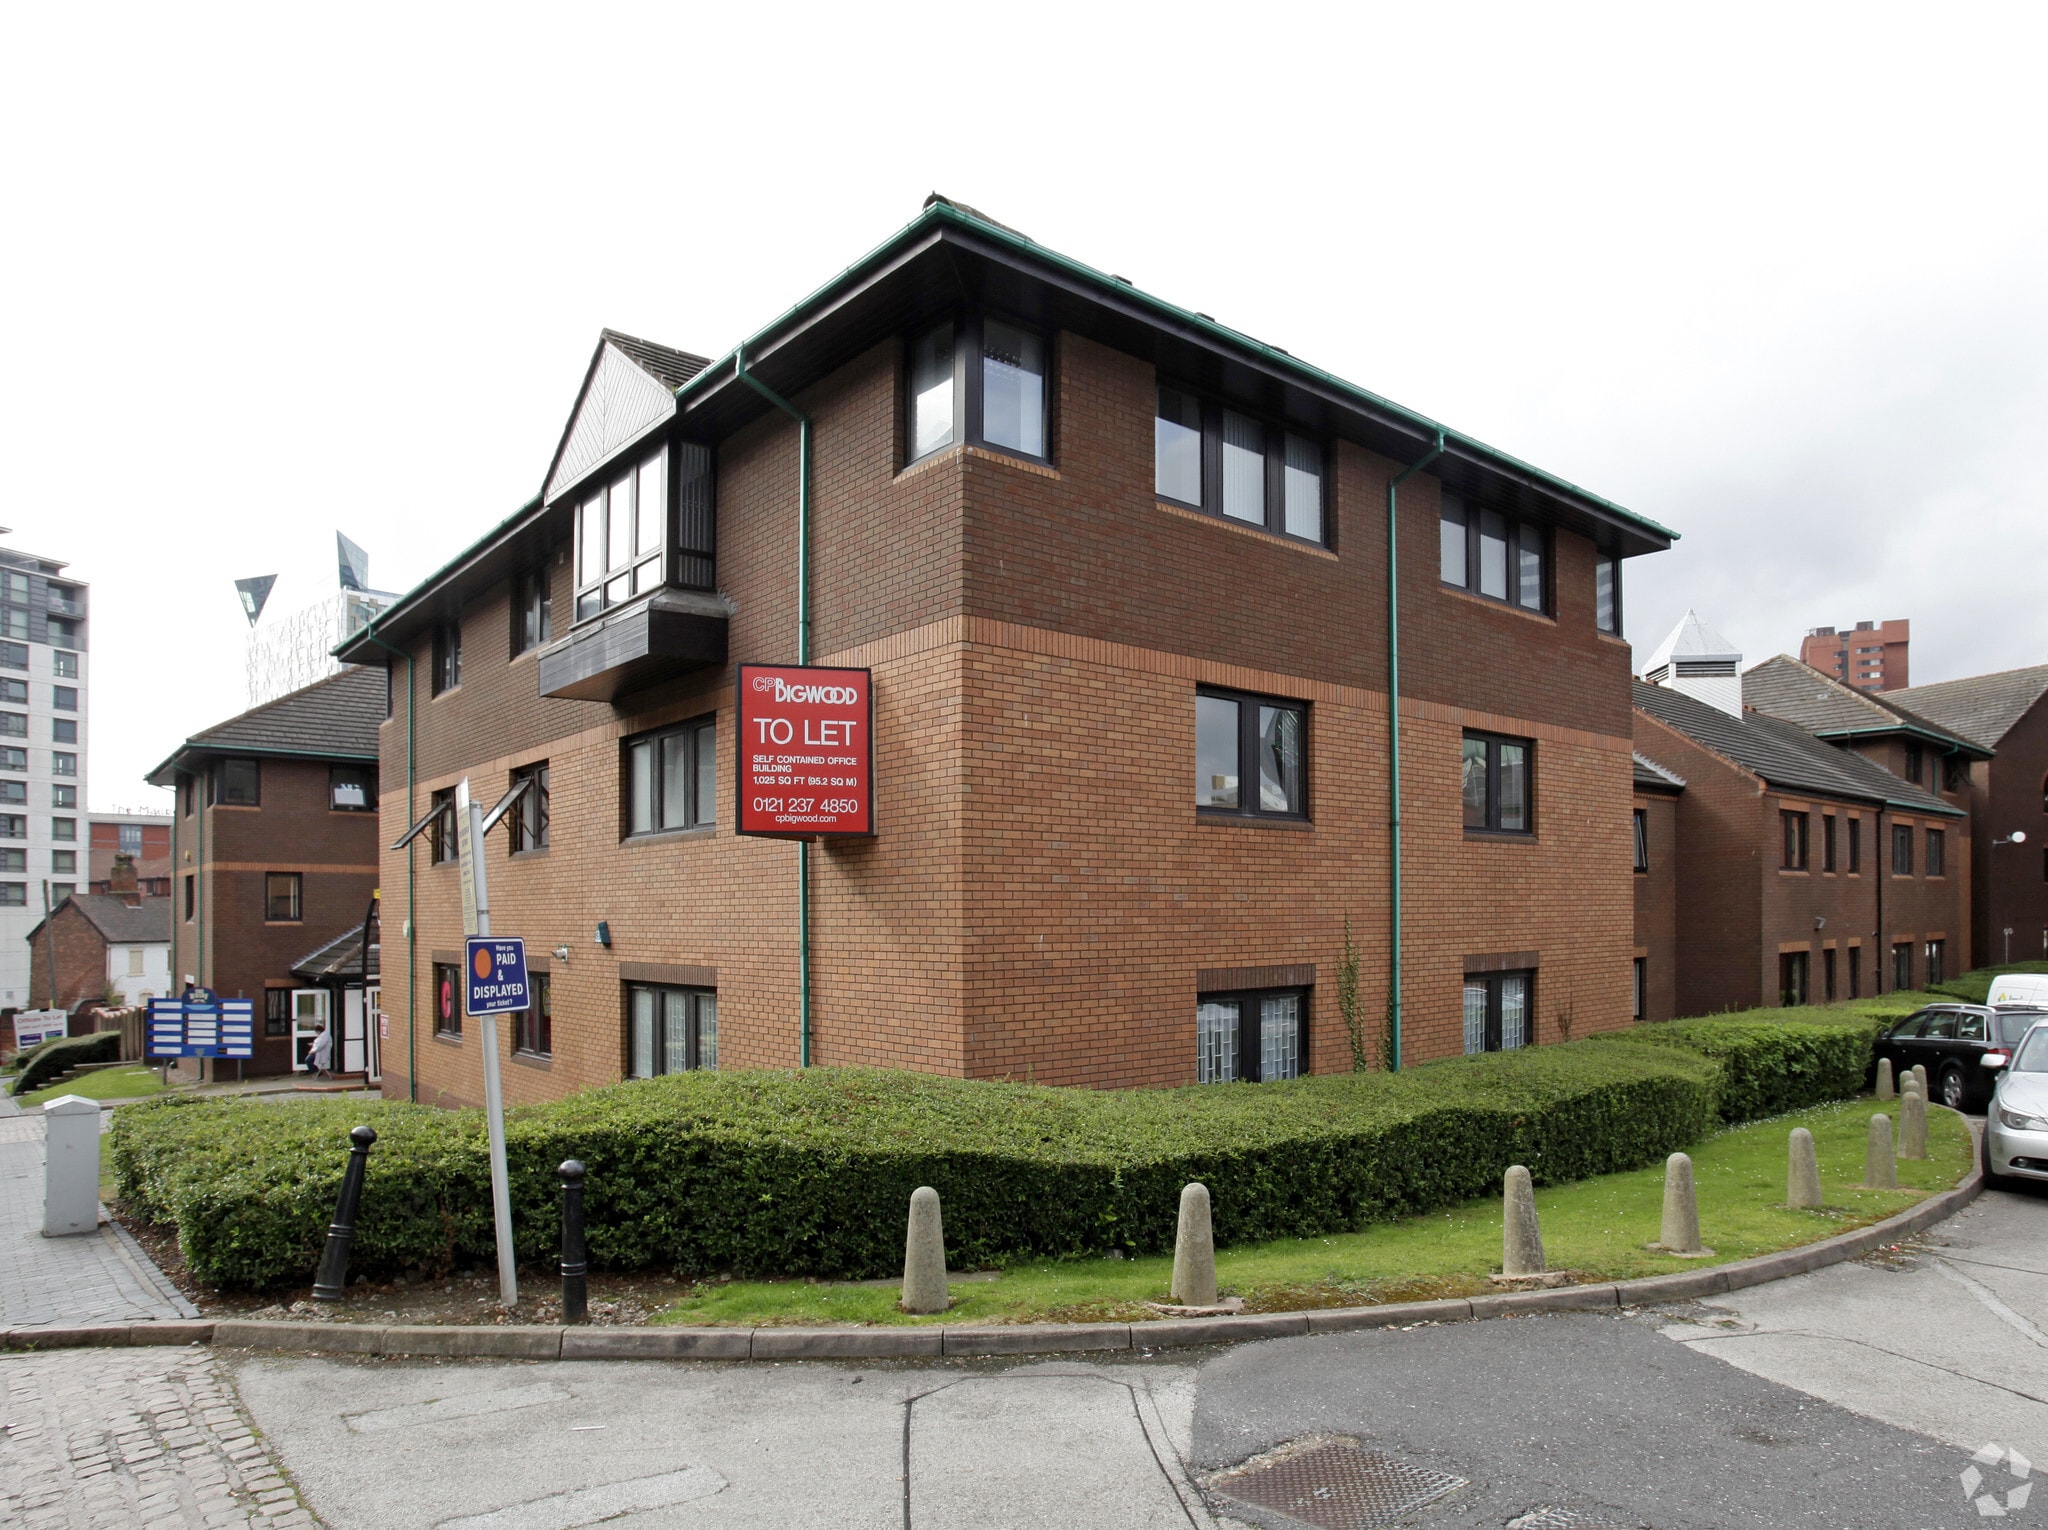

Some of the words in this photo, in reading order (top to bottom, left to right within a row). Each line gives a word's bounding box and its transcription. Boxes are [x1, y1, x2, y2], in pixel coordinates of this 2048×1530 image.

[752, 717, 794, 745] TO
[804, 719, 857, 747] LET
[752, 754, 774, 763] SELF
[776, 755, 825, 765] CONTAINED
[827, 756, 858, 766] OFFICE
[752, 764, 792, 773] BUILDING
[753, 776, 775, 785] 1,025
[778, 776, 791, 785] SQ
[793, 776, 805, 784] FT
[808, 777, 828, 786] (95.2
[830, 777, 844, 786] SQ
[845, 777, 857, 787] M)
[753, 797, 783, 812] 0121
[788, 797, 815, 813] 237
[820, 798, 858, 813] 4850
[775, 813, 837, 824] cpbigwood.com
[495, 944, 506, 952] Have
[496, 952, 517, 966] PAID
[497, 968, 504, 981] &
[473, 983, 524, 1000] DISPLAYED
[486, 1001, 497, 1009] your
[497, 999, 513, 1007] ticket?
